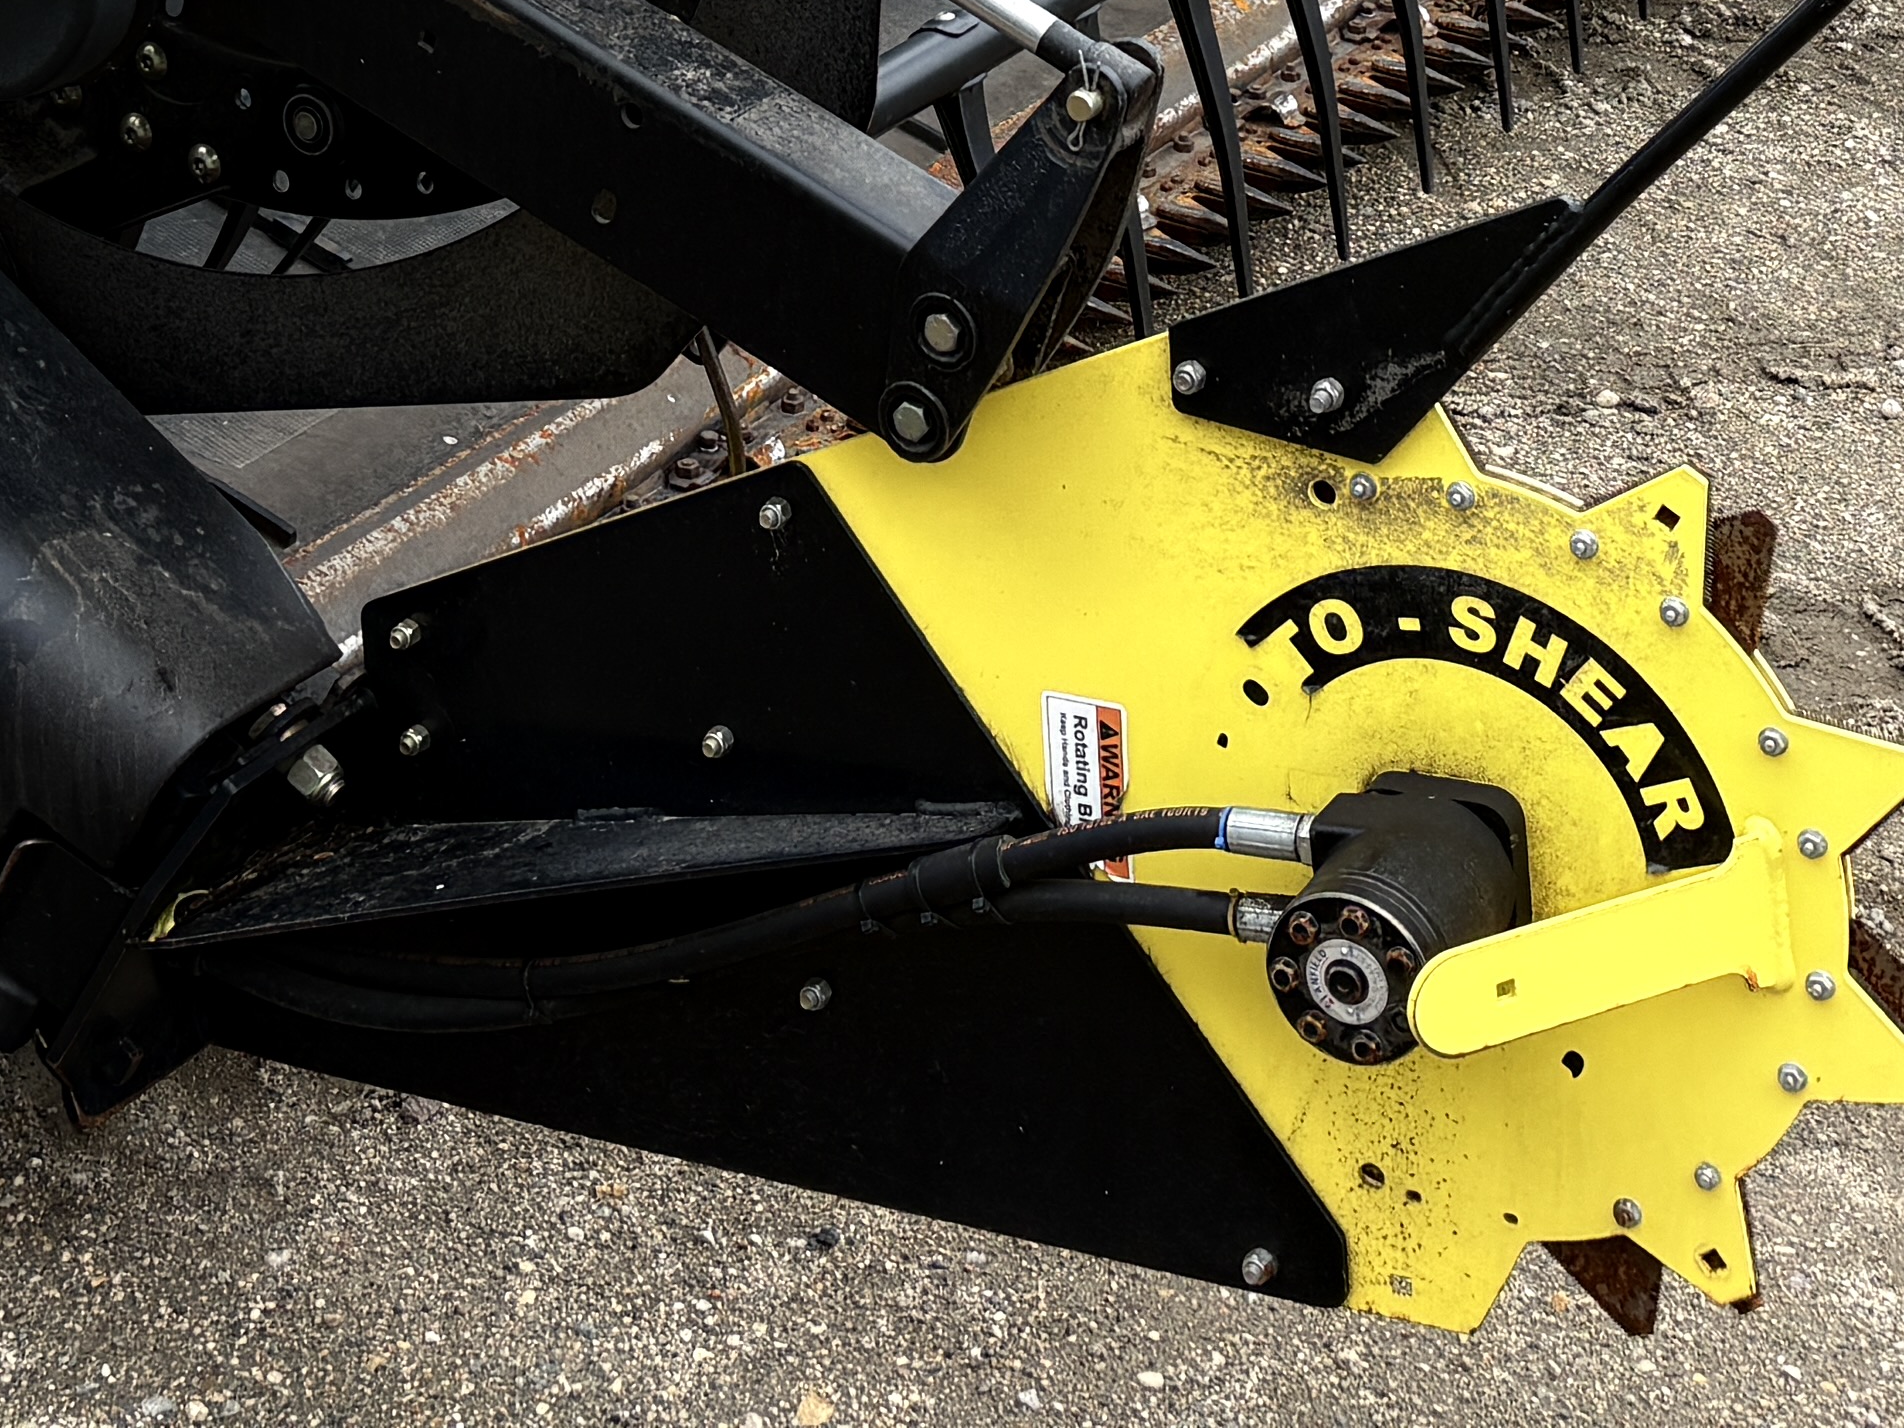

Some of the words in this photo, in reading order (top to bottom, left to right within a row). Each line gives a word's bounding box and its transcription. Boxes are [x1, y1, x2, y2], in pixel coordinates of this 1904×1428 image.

[1059, 712, 1067, 736] Keep
[1448, 595, 1706, 841] SHEAR
[1061, 738, 1069, 767] Hands
[1073, 715, 1091, 797] Rotating
